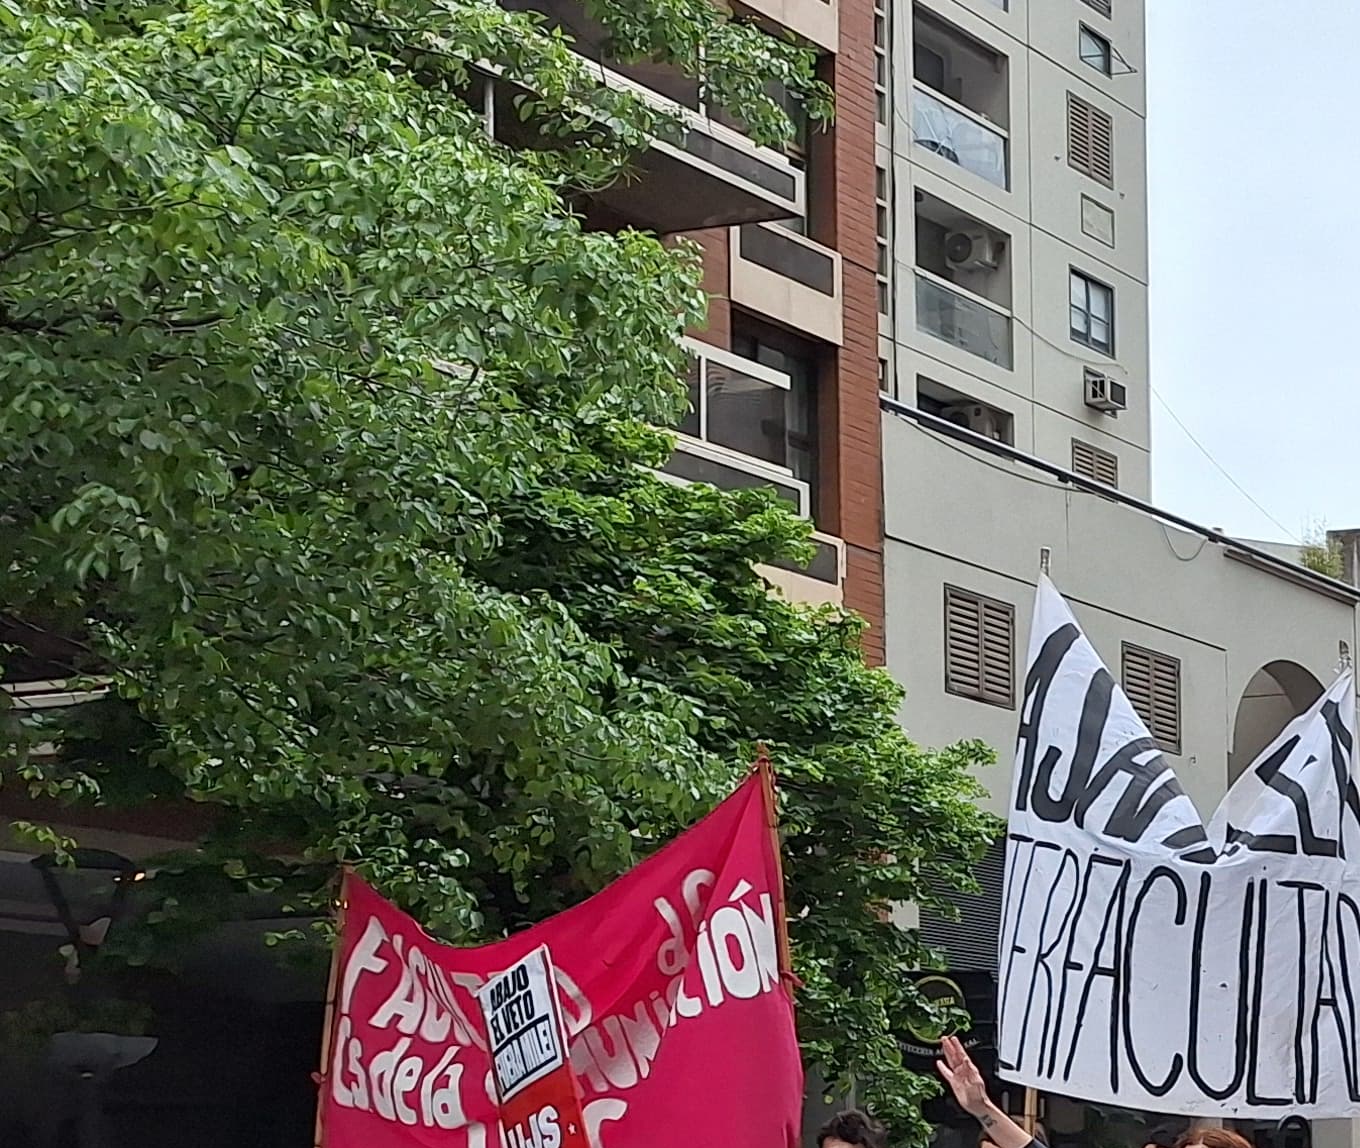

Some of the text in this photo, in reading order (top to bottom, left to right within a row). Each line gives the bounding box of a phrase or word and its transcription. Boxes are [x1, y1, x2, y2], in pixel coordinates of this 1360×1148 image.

[490, 964, 530, 1014] ABAJO
[490, 990, 535, 1046] EL VETO
